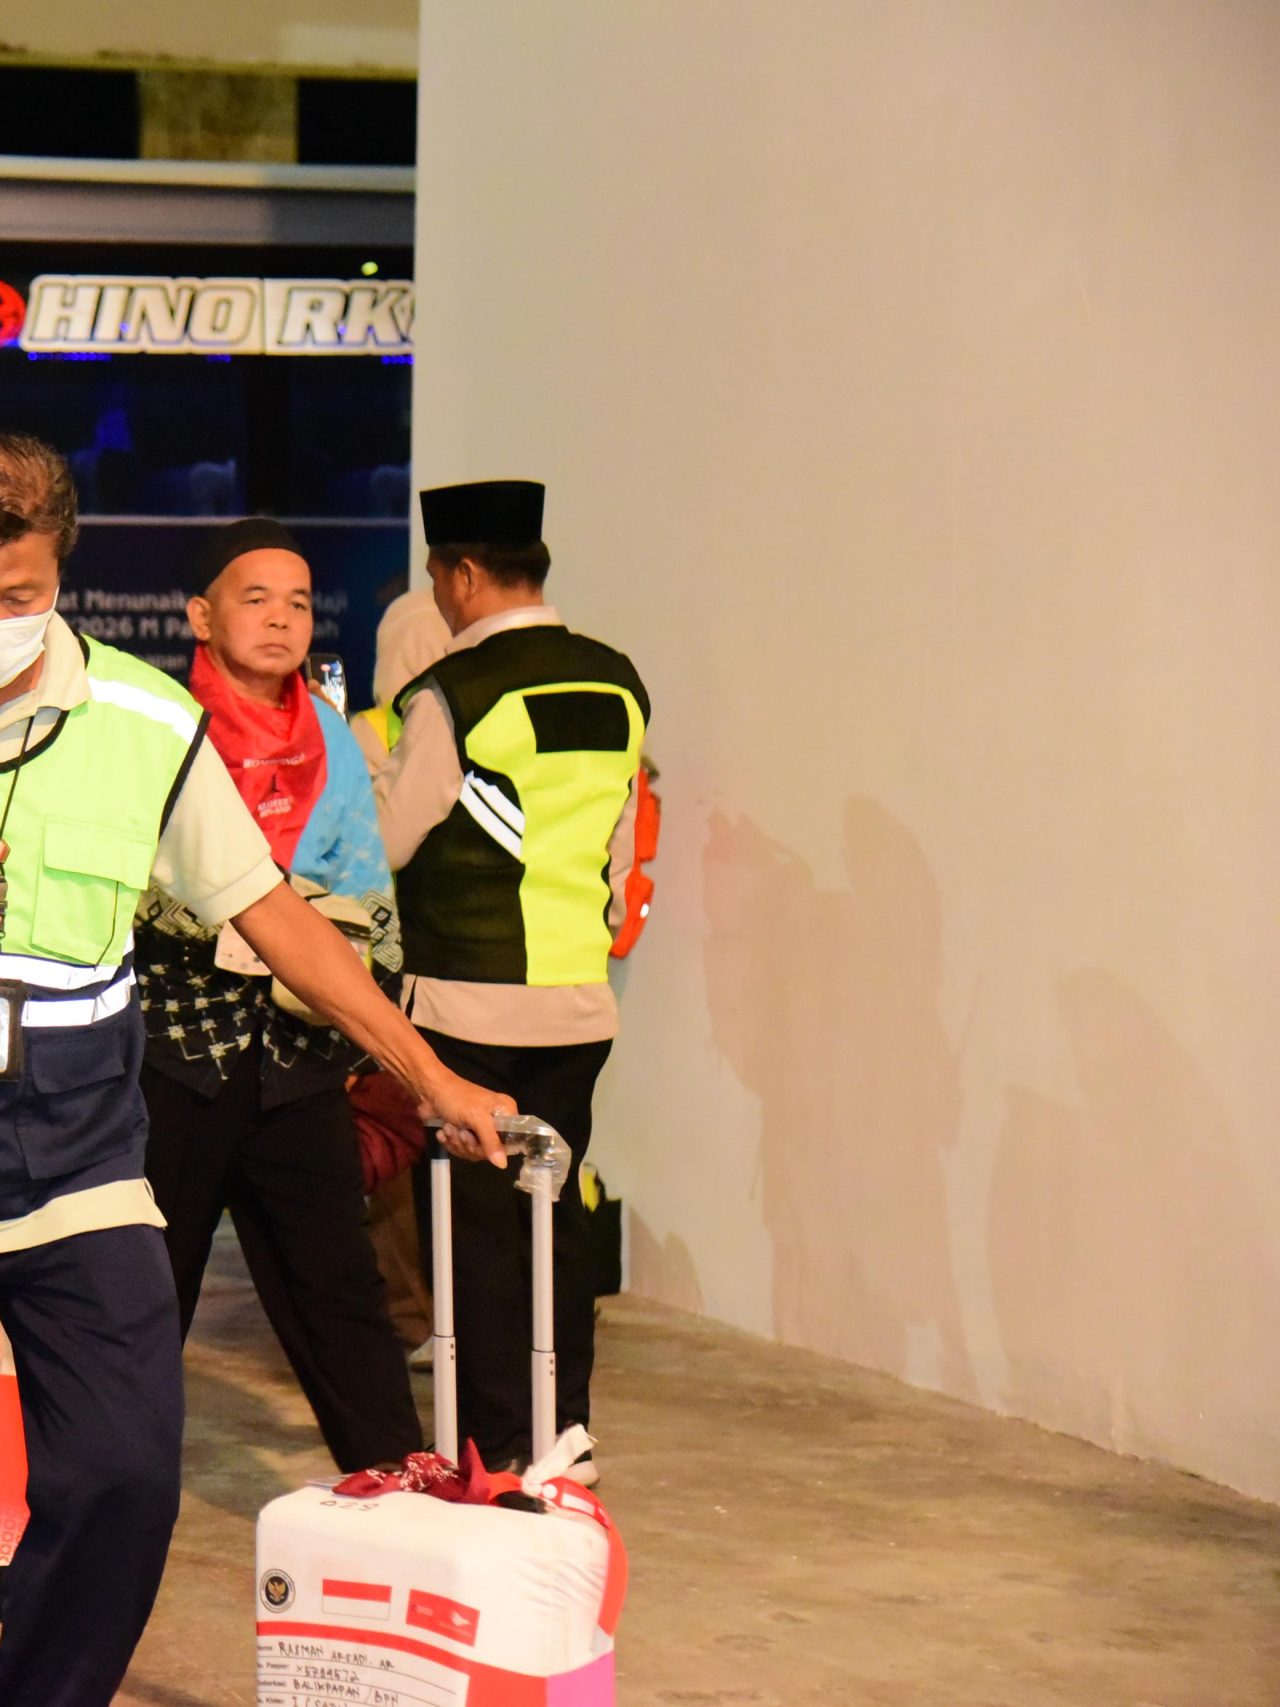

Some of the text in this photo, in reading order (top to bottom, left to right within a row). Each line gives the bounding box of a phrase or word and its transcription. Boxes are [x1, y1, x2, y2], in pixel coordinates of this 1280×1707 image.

[26, 281, 415, 347] HINO RK
[293, 1679, 360, 1699] BALIKPAPAN
